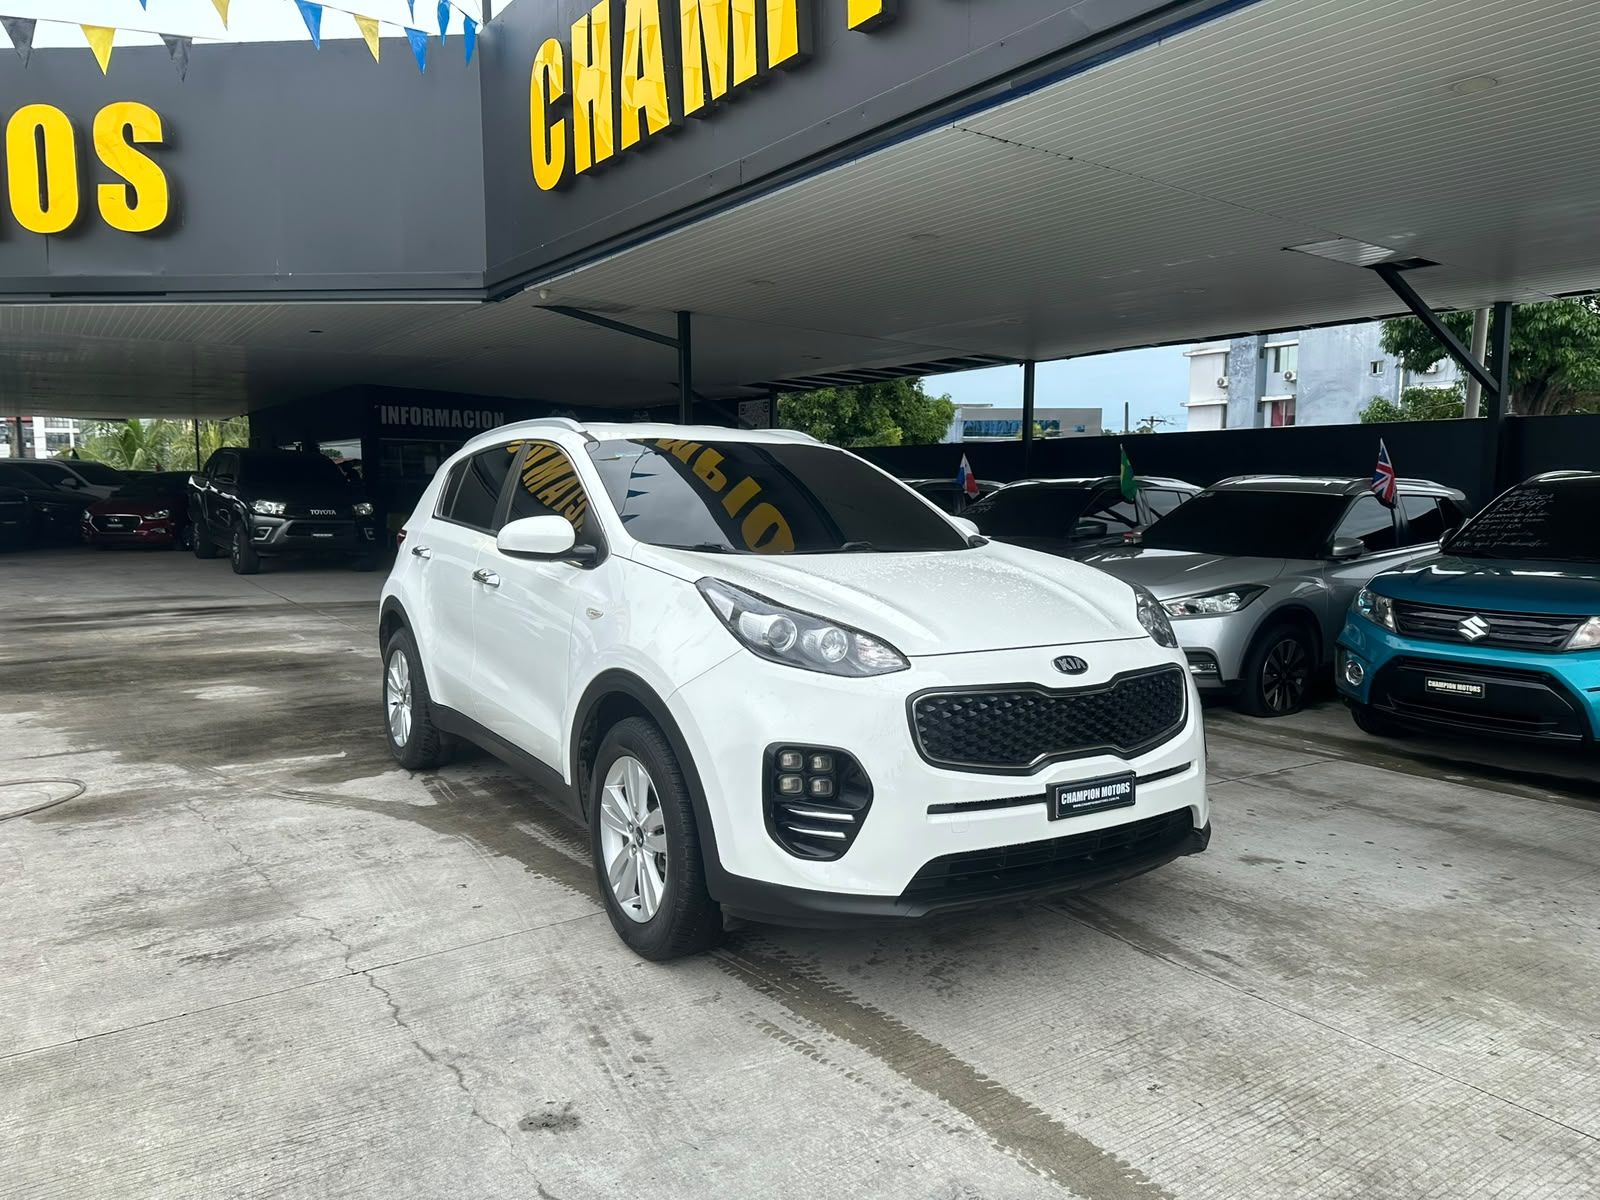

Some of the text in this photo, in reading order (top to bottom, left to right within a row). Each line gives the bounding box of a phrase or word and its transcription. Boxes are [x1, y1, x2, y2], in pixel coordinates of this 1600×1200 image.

[6, 101, 169, 234] OS
[380, 405, 504, 429] INFORMACION
[1056, 657, 1087, 671] KIA
[1061, 787, 1101, 805] CHAMPION
[1101, 782, 1131, 797] MOTORS
